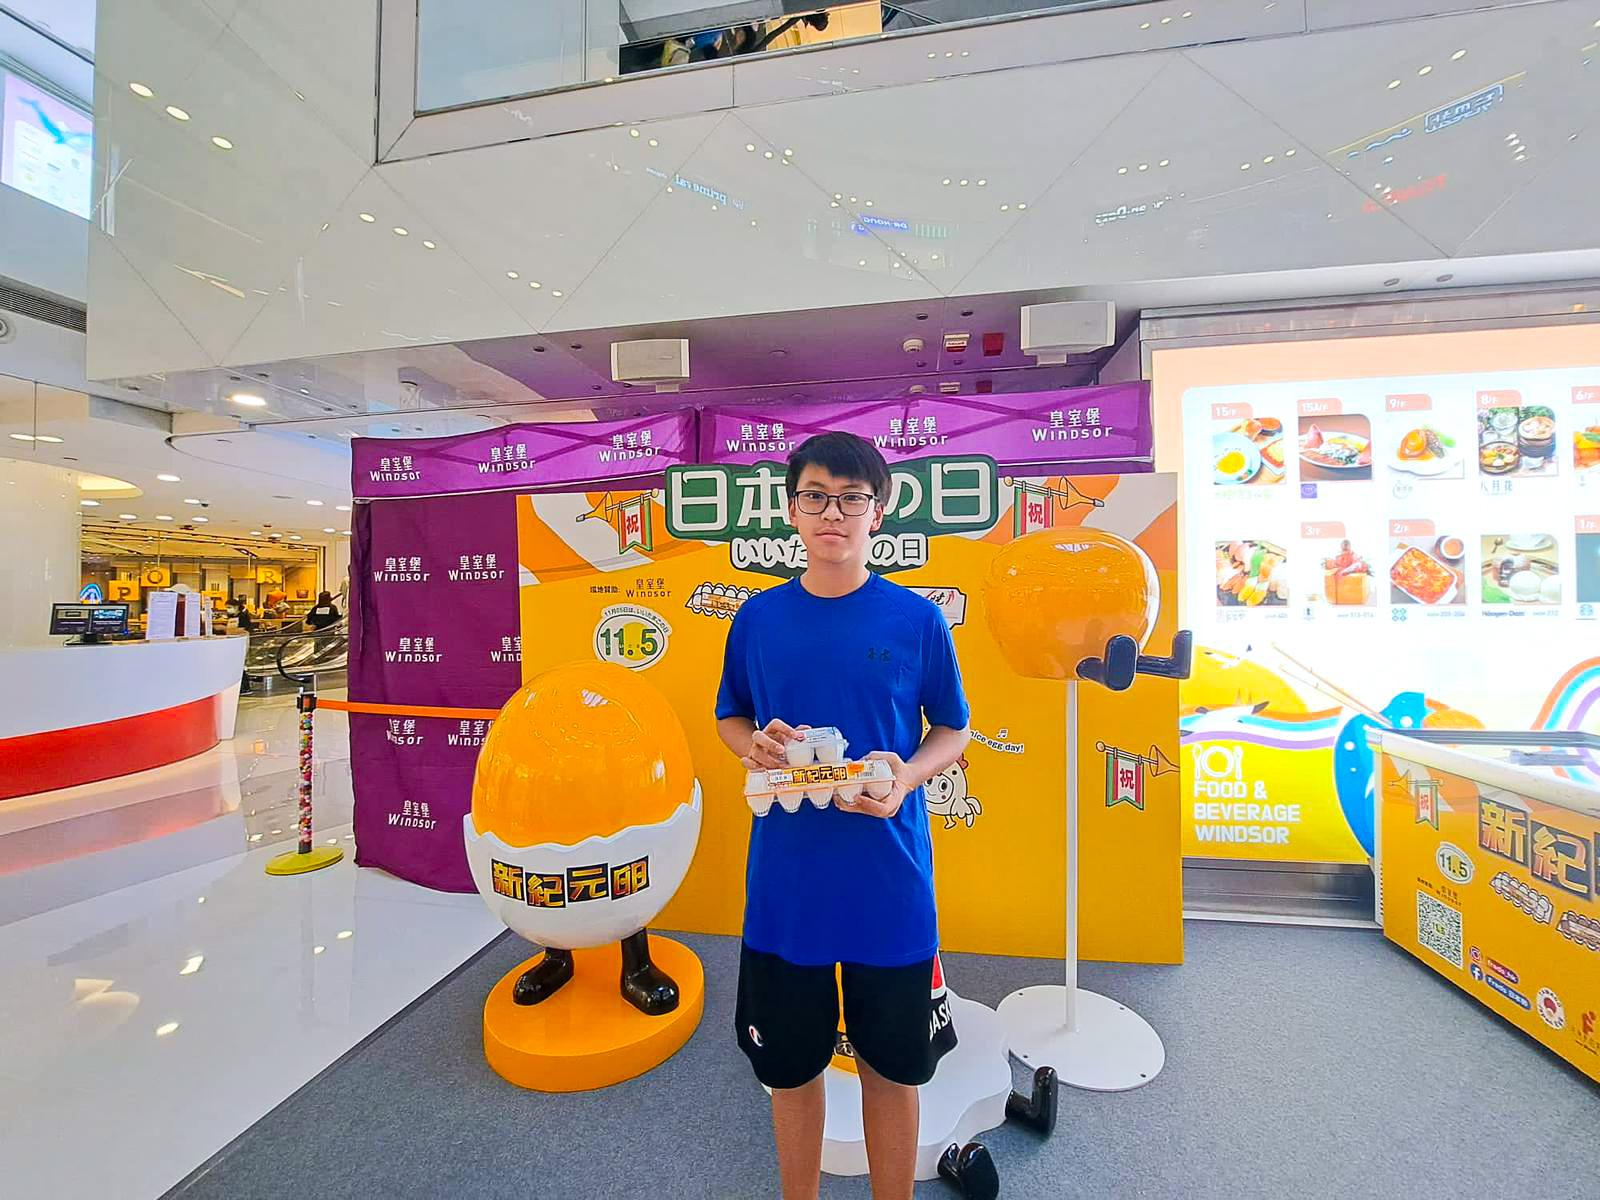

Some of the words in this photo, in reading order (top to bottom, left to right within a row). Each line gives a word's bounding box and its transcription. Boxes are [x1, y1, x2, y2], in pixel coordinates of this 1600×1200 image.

[888, 416, 937, 437] 皇室堡
[1049, 407, 1101, 429] 皇室堡
[612, 430, 652, 450] 皇室堡
[740, 423, 786, 441] 皇室堡
[873, 433, 949, 448] Windsor
[1032, 424, 1113, 442] Windsor
[490, 443, 528, 463] 皇室堡
[598, 445, 661, 463] Windsor
[726, 438, 796, 453] Windsor
[380, 455, 413, 471] 皇室堡
[478, 459, 536, 474] Windsor
[369, 471, 421, 483] Windsor
[1027, 501, 1044, 526] 祝
[626, 513, 640, 535] 祝
[385, 556, 422, 572] 皇室堡
[459, 553, 497, 569] 皇室堡
[373, 571, 431, 582] Windsor
[448, 569, 505, 581] Windsor
[636, 577, 665, 589] 皇室堡
[626, 589, 672, 598] Windsor
[398, 636, 435, 652] 皇室堡
[600, 628, 659, 656] 11.5
[384, 651, 443, 663] Windsor
[1004, 744, 1024, 753] day!
[1119, 767, 1135, 790] 祝
[1193, 781, 1247, 799] FOOD
[1254, 780, 1267, 800] &
[402, 800, 430, 818] 皇室堡
[1193, 802, 1300, 822] BEVERAGE
[388, 813, 436, 830] Windsor
[1195, 824, 1290, 844] WINDSOR
[1439, 853, 1468, 878] 11.5
